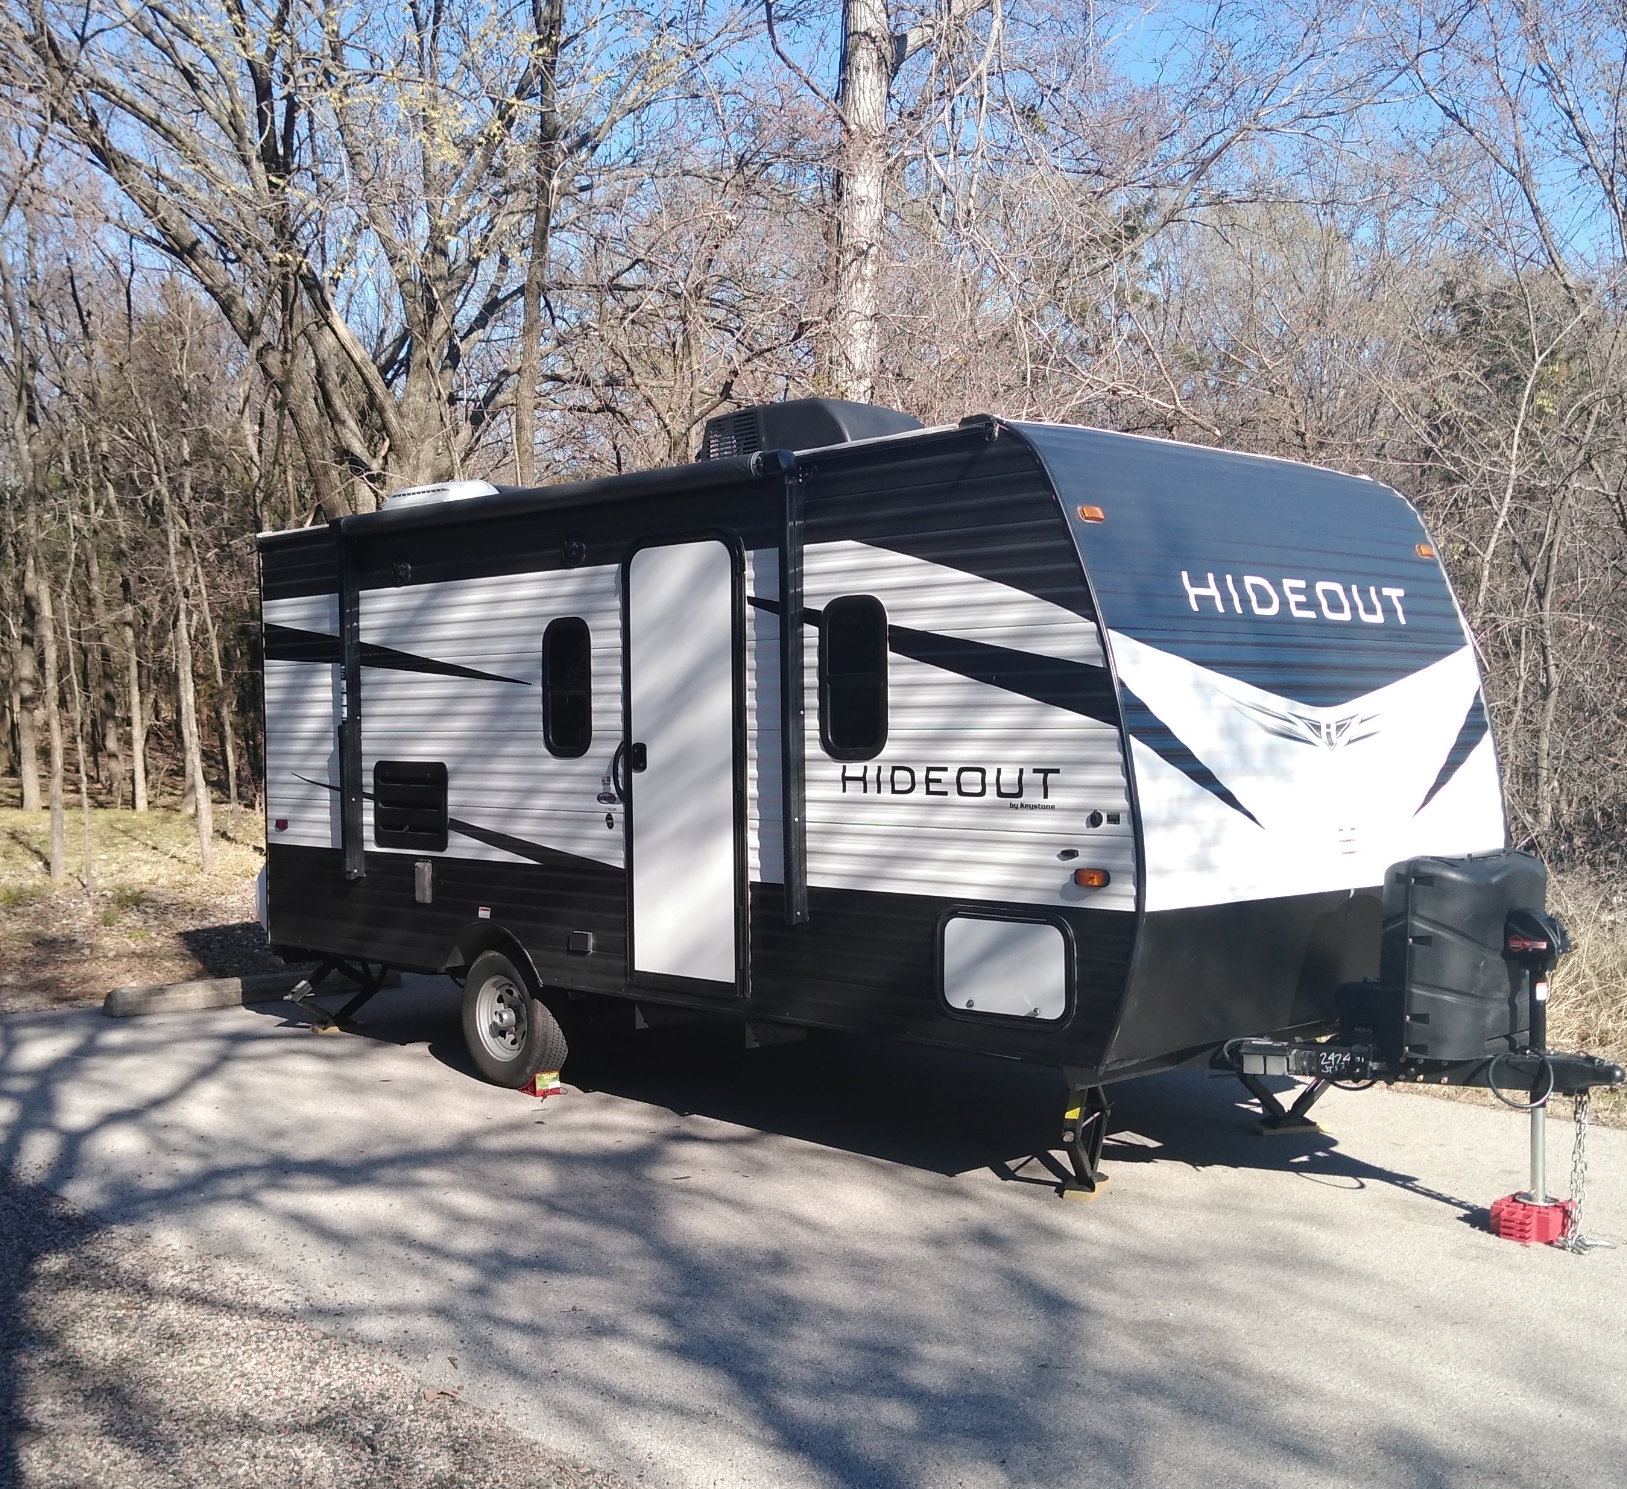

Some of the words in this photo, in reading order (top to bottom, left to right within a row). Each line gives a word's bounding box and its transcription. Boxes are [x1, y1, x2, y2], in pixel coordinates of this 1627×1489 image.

[1180, 570, 1407, 625] HIDEOUT
[841, 764, 1061, 800] HIDEOUT
[1009, 801, 1018, 810] by
[1019, 802, 1056, 810] Keystone
